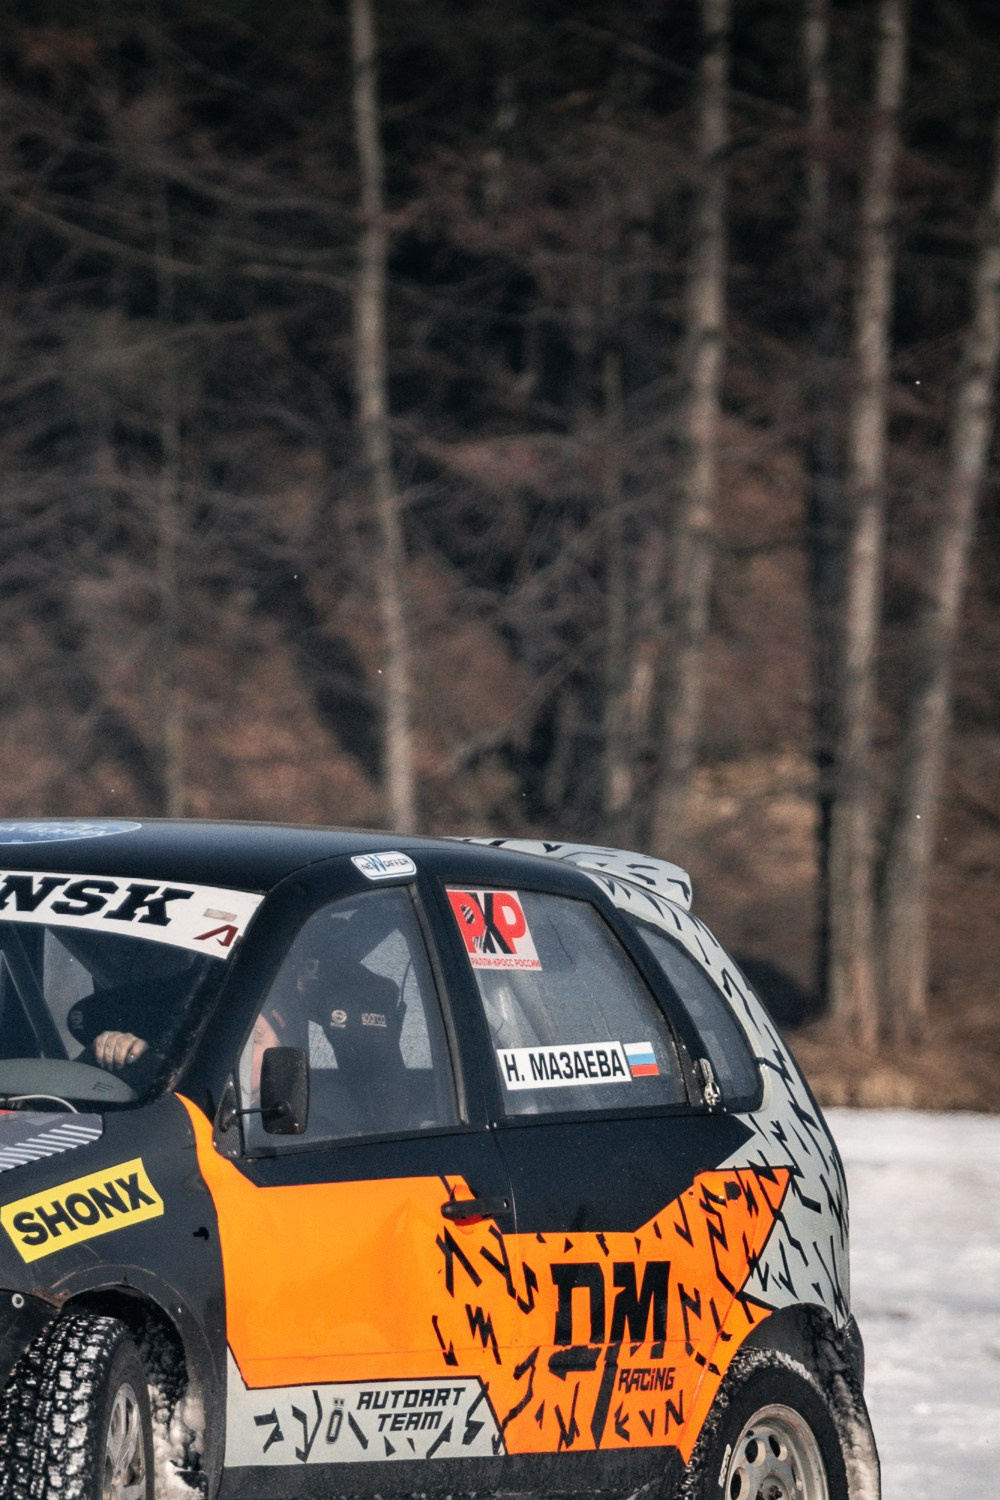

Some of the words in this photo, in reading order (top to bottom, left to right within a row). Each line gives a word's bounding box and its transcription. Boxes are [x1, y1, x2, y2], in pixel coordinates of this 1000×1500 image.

[503, 1054, 526, 1082] Н.
[529, 1049, 626, 1081] МАЗАЕВА
[12, 1172, 157, 1246] SHONX
[356, 1386, 467, 1411] AUTOART
[377, 1410, 444, 1433] TEAM
